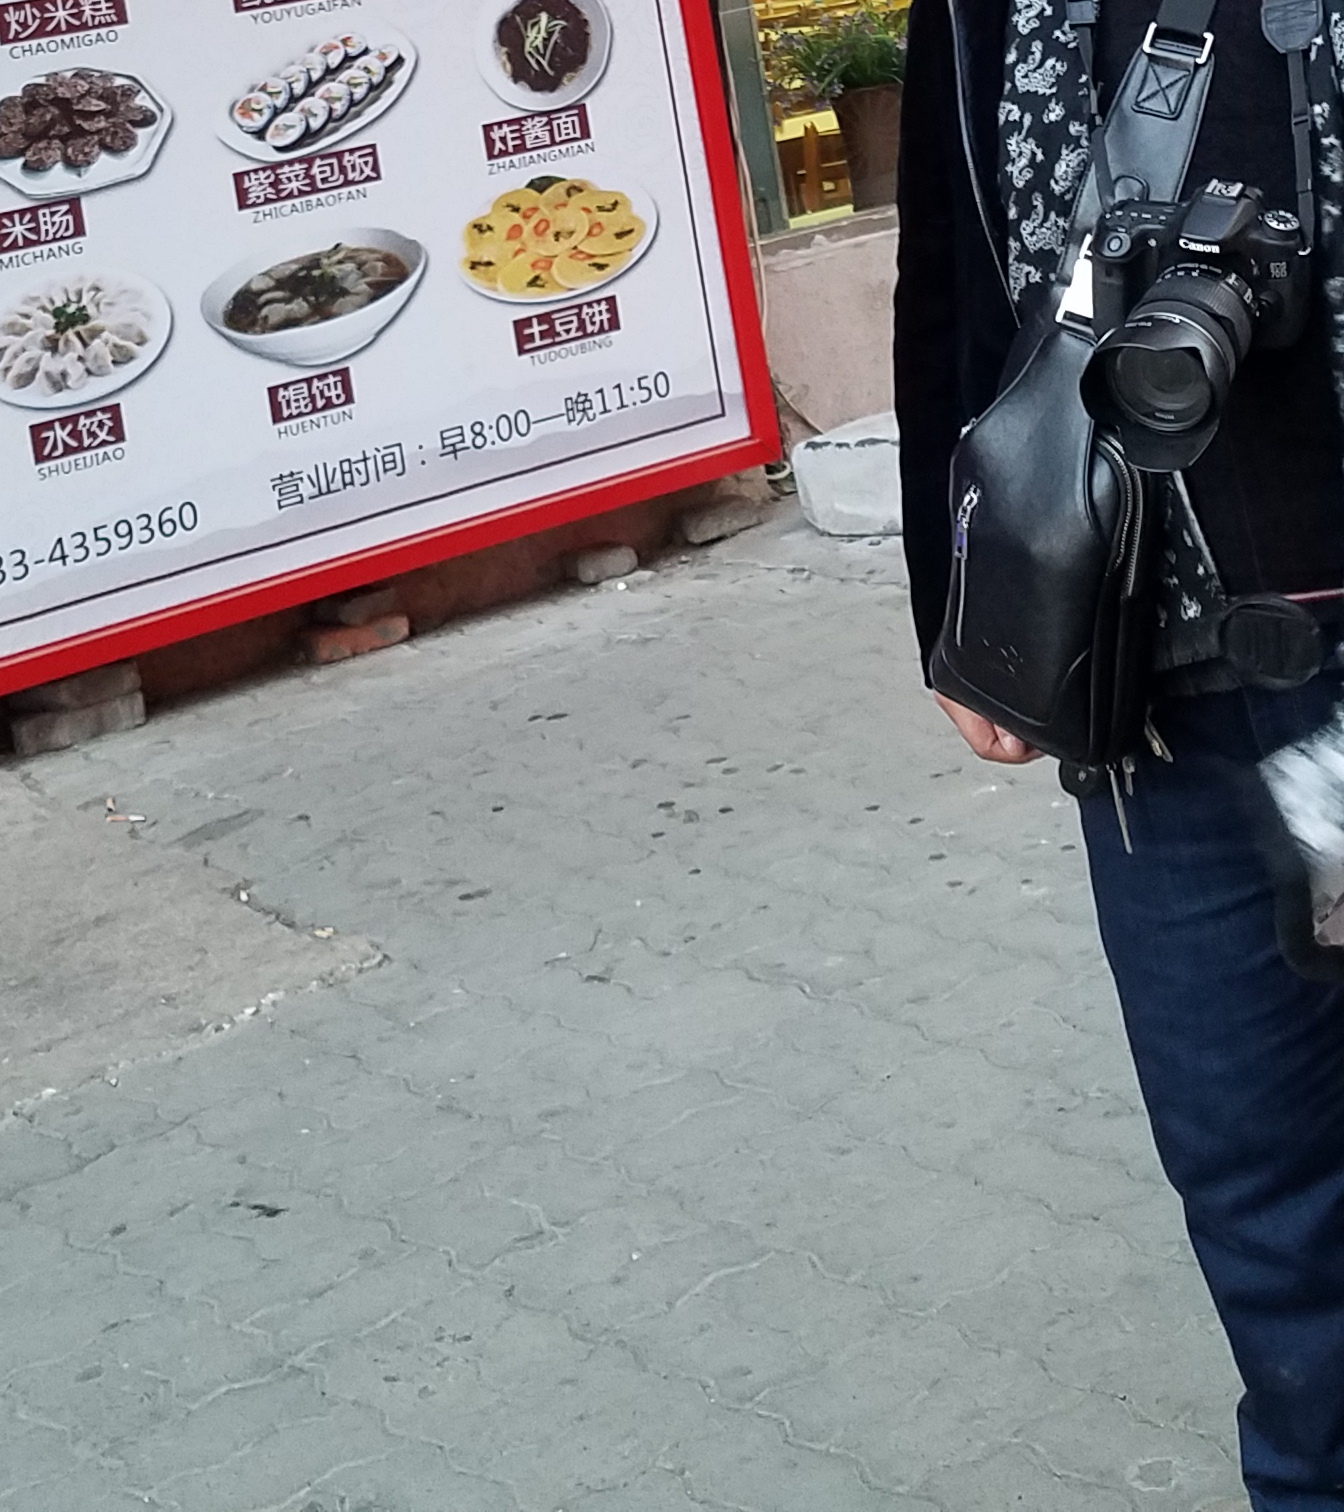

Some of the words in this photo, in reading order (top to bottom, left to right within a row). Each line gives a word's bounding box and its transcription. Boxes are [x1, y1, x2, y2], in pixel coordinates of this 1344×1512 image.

[8, 30, 119, 61] CHAOMIGAO
[489, 112, 582, 155] 炸酱面
[242, 150, 379, 206] 紫菜包饭
[487, 140, 596, 176] ZHAJIANGMIAN
[251, 186, 367, 224] ZHICAIBAOFAN
[0, 208, 74, 250] 米肠
[1178, 238, 1221, 254] Canon
[522, 302, 613, 349] 土豆饼
[529, 334, 614, 367] TUDOUBING
[276, 373, 347, 419] 馄饨
[39, 410, 117, 457] 水饺
[276, 408, 354, 440] HUENTUN
